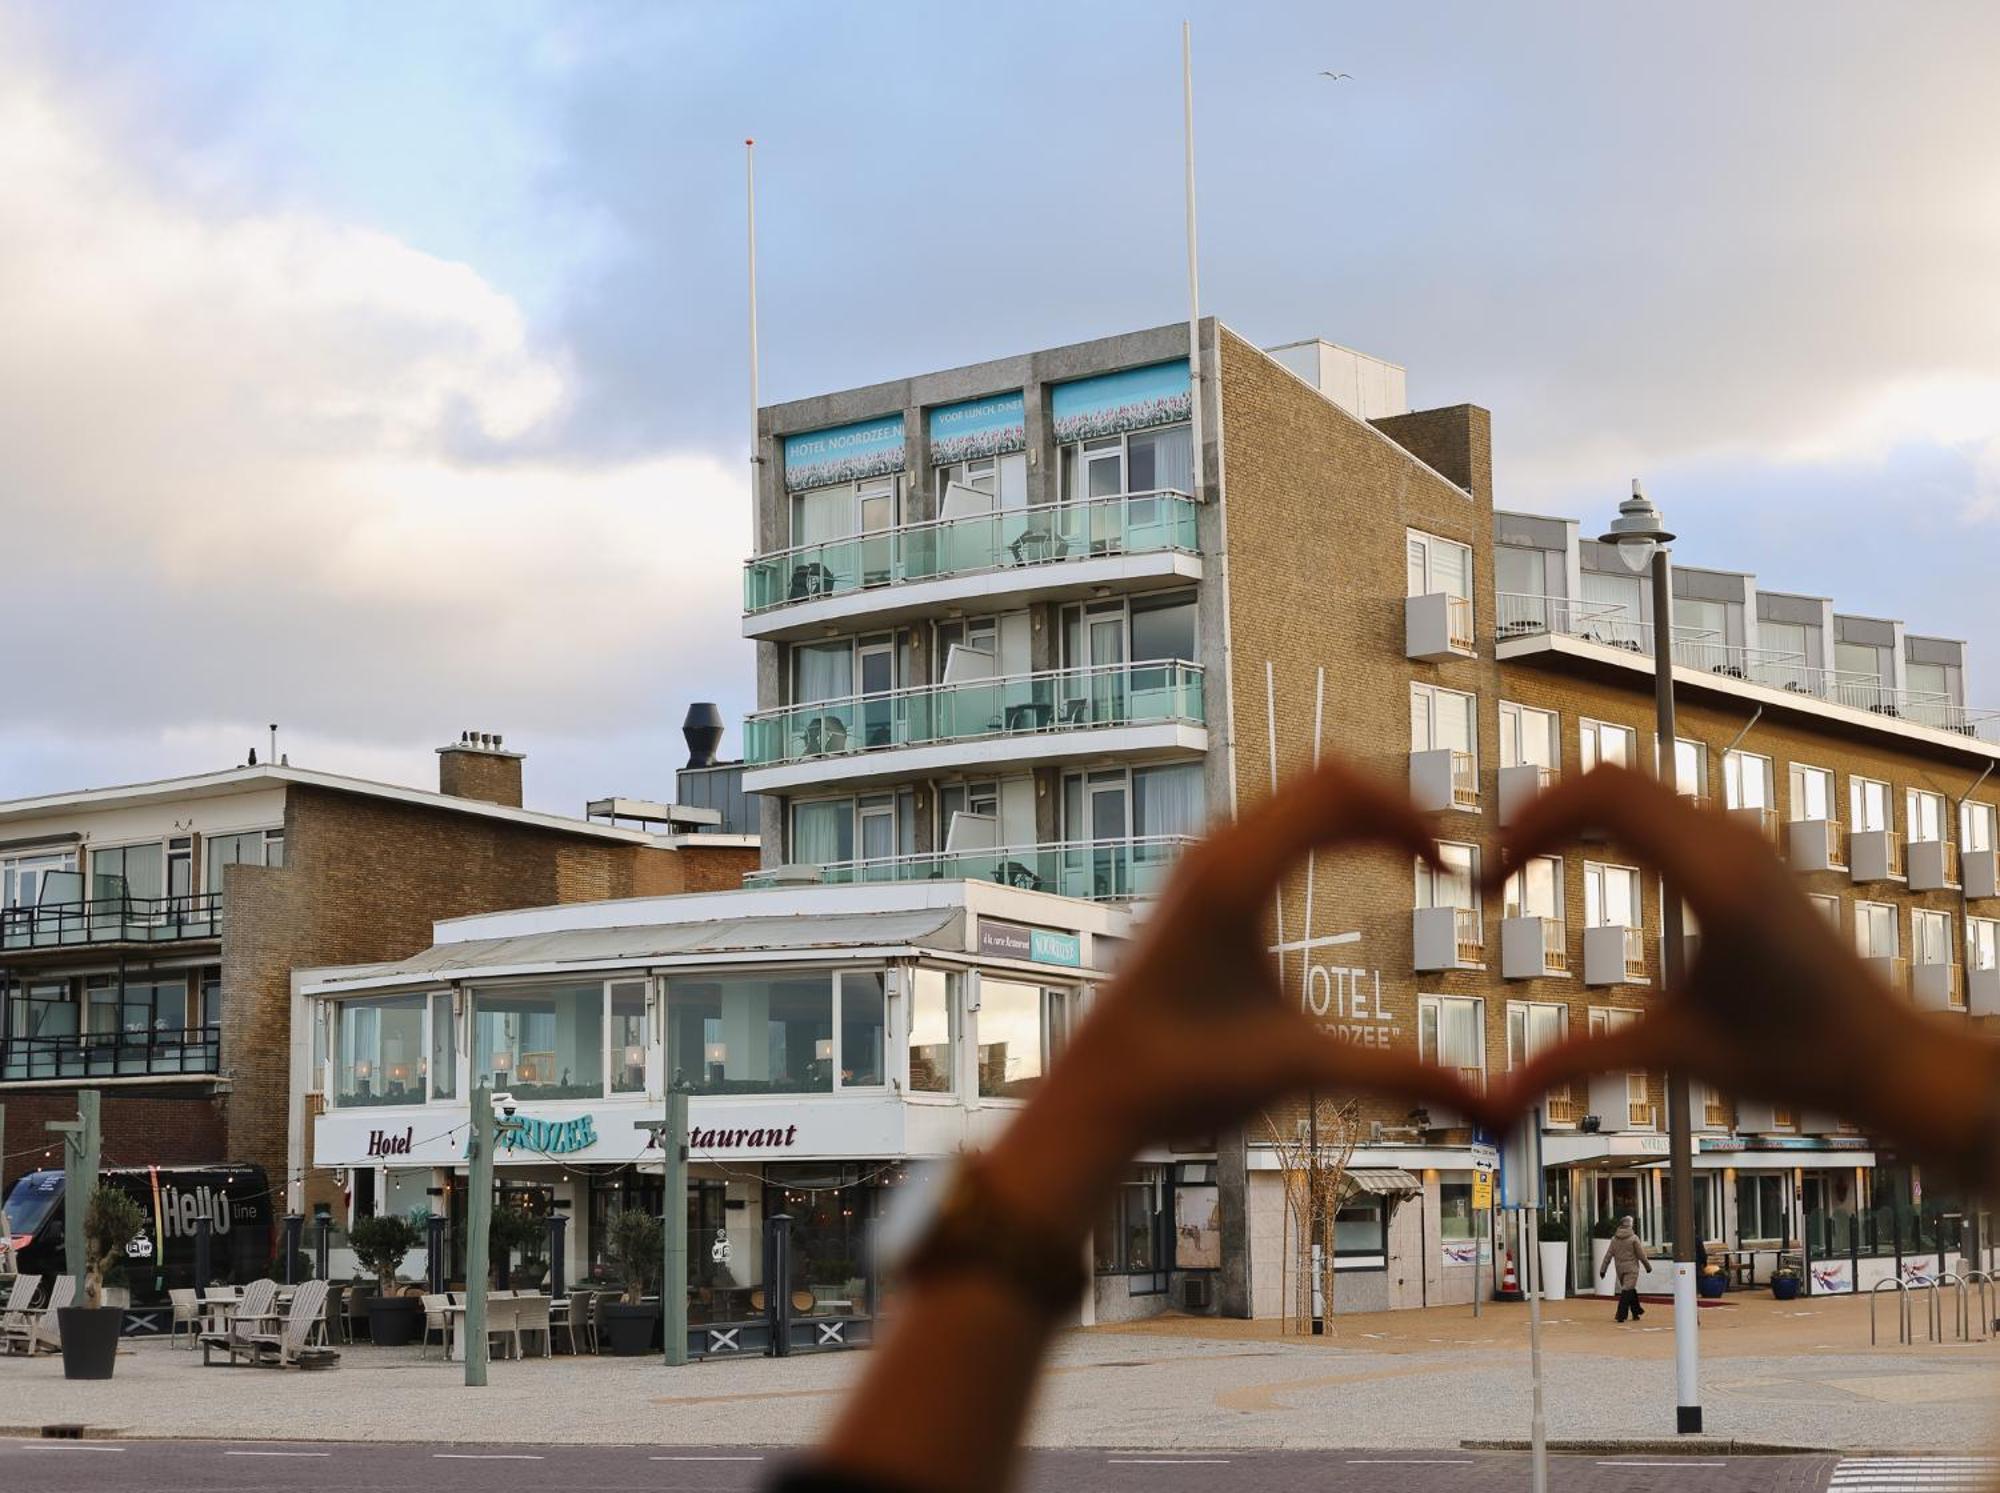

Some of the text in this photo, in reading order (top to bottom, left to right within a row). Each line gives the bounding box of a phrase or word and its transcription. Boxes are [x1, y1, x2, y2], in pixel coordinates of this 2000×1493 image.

[790, 441, 826, 457] HOTEL
[367, 1126, 413, 1156] Hotel
[646, 1124, 797, 1149] Rtaurant
[161, 1186, 231, 1238] Hello
